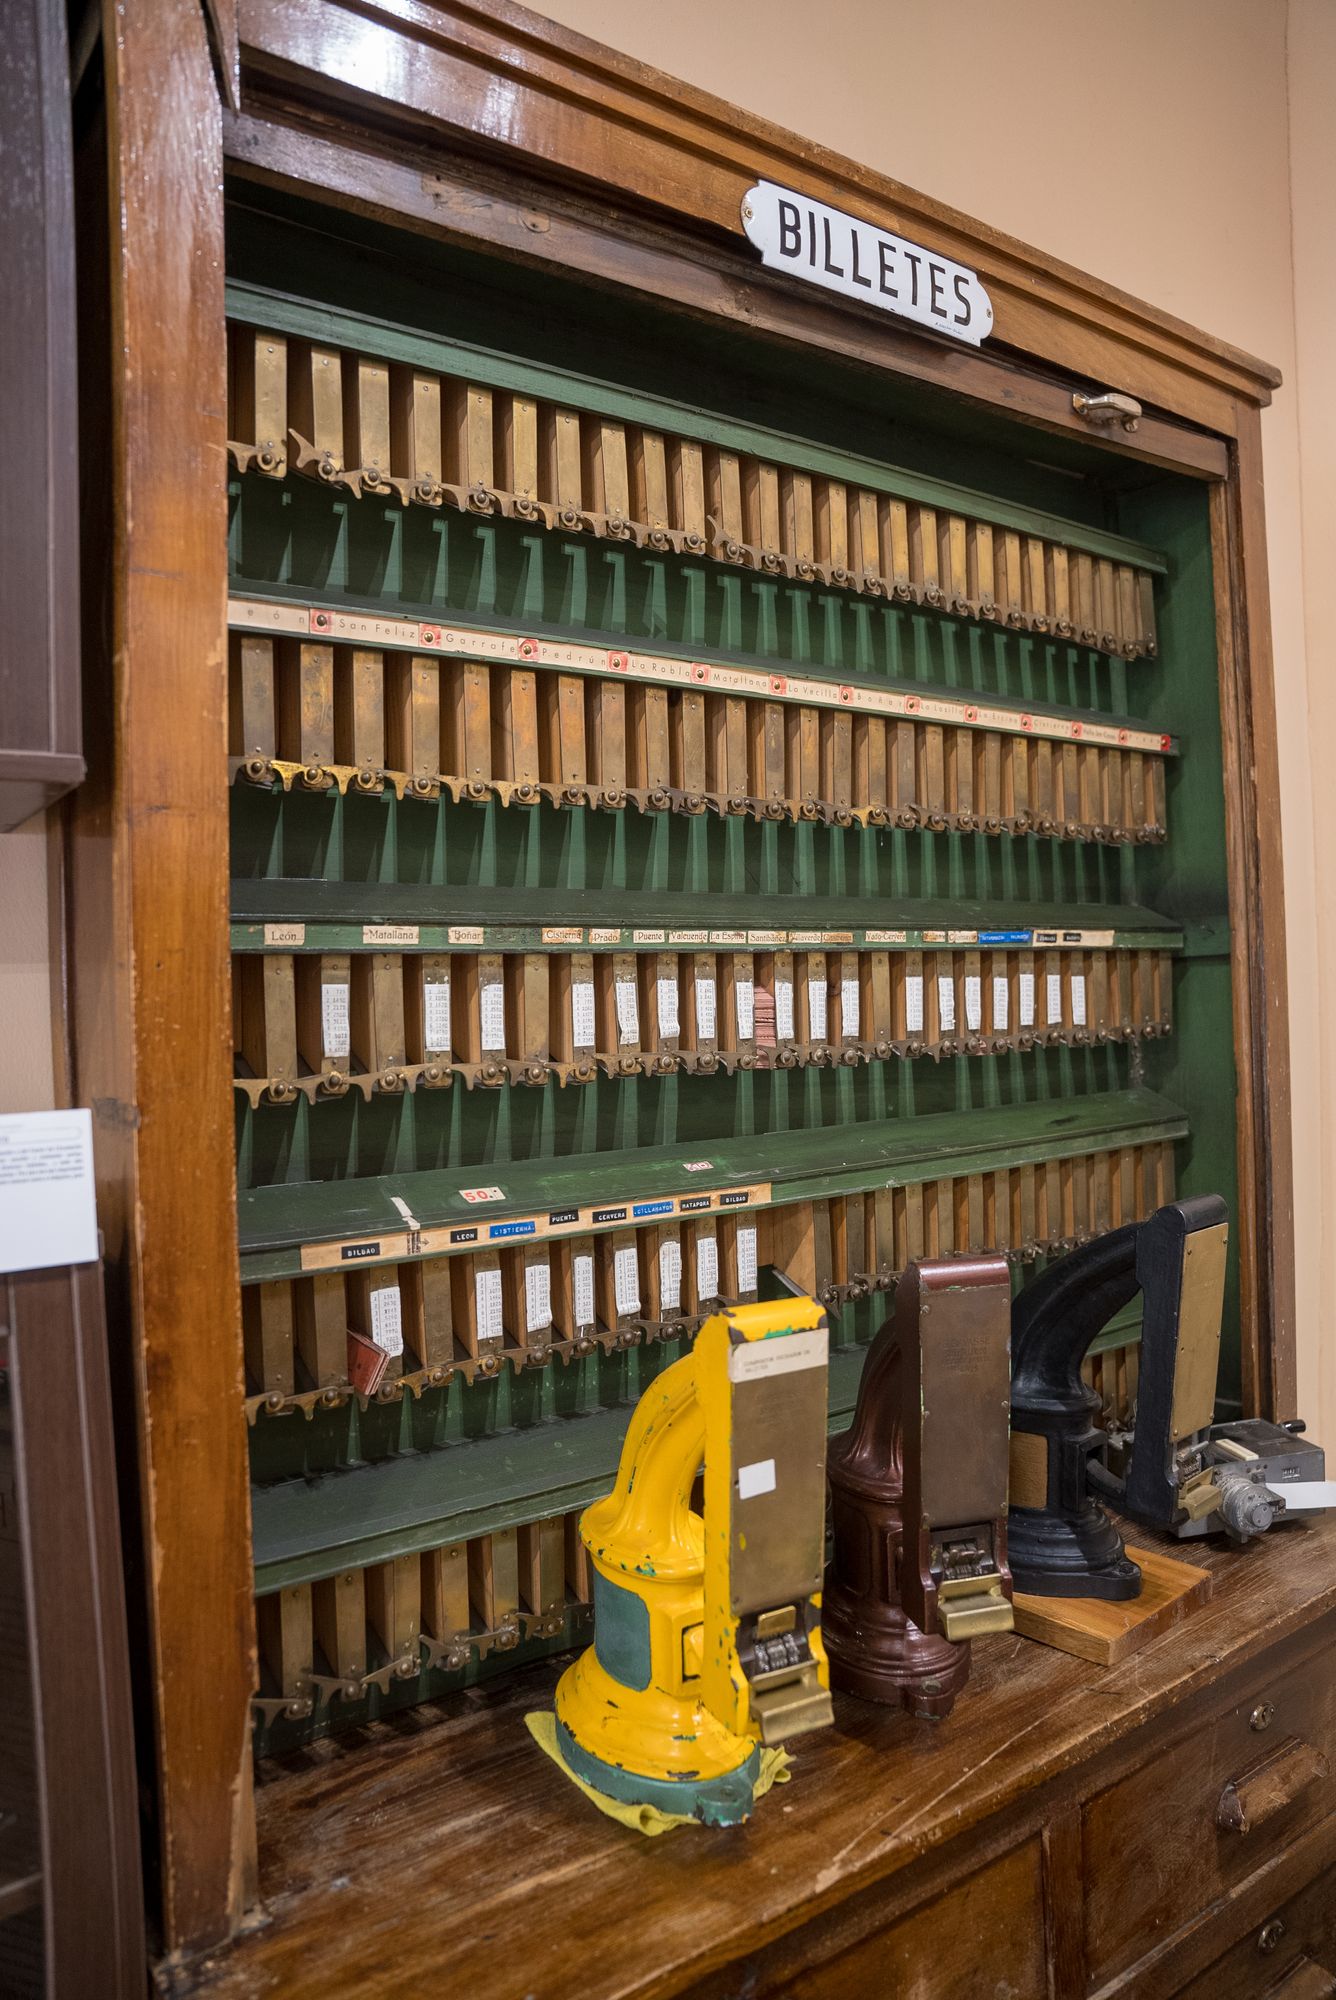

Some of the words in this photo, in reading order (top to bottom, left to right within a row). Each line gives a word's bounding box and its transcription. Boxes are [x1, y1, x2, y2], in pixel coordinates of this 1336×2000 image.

[778, 198, 971, 327] BILLETES
[247, 609, 305, 624] eón
[339, 619, 367, 631] San
[375, 624, 415, 639] Feliz
[445, 634, 515, 653] Garrafe
[542, 648, 606, 666] Pedrún
[631, 659, 646, 670] La
[652, 663, 690, 678] Robla
[713, 673, 767, 688] Matallana
[788, 683, 798, 693] La
[802, 685, 837, 699] Vecilla
[271, 931, 297, 942] León
[369, 929, 414, 940] Matallana
[453, 930, 481, 941] Boñar
[546, 930, 581, 939] Cistierna
[594, 933, 618, 942] Prado
[638, 932, 662, 941] Puente
[671, 931, 707, 940] Valcuende
[711, 932, 720, 940] La
[551, 1214, 576, 1223] PUENTE
[598, 1212, 627, 1221] CERVERA
[456, 1232, 475, 1241] LEON
[347, 1247, 376, 1257] BILBAO
